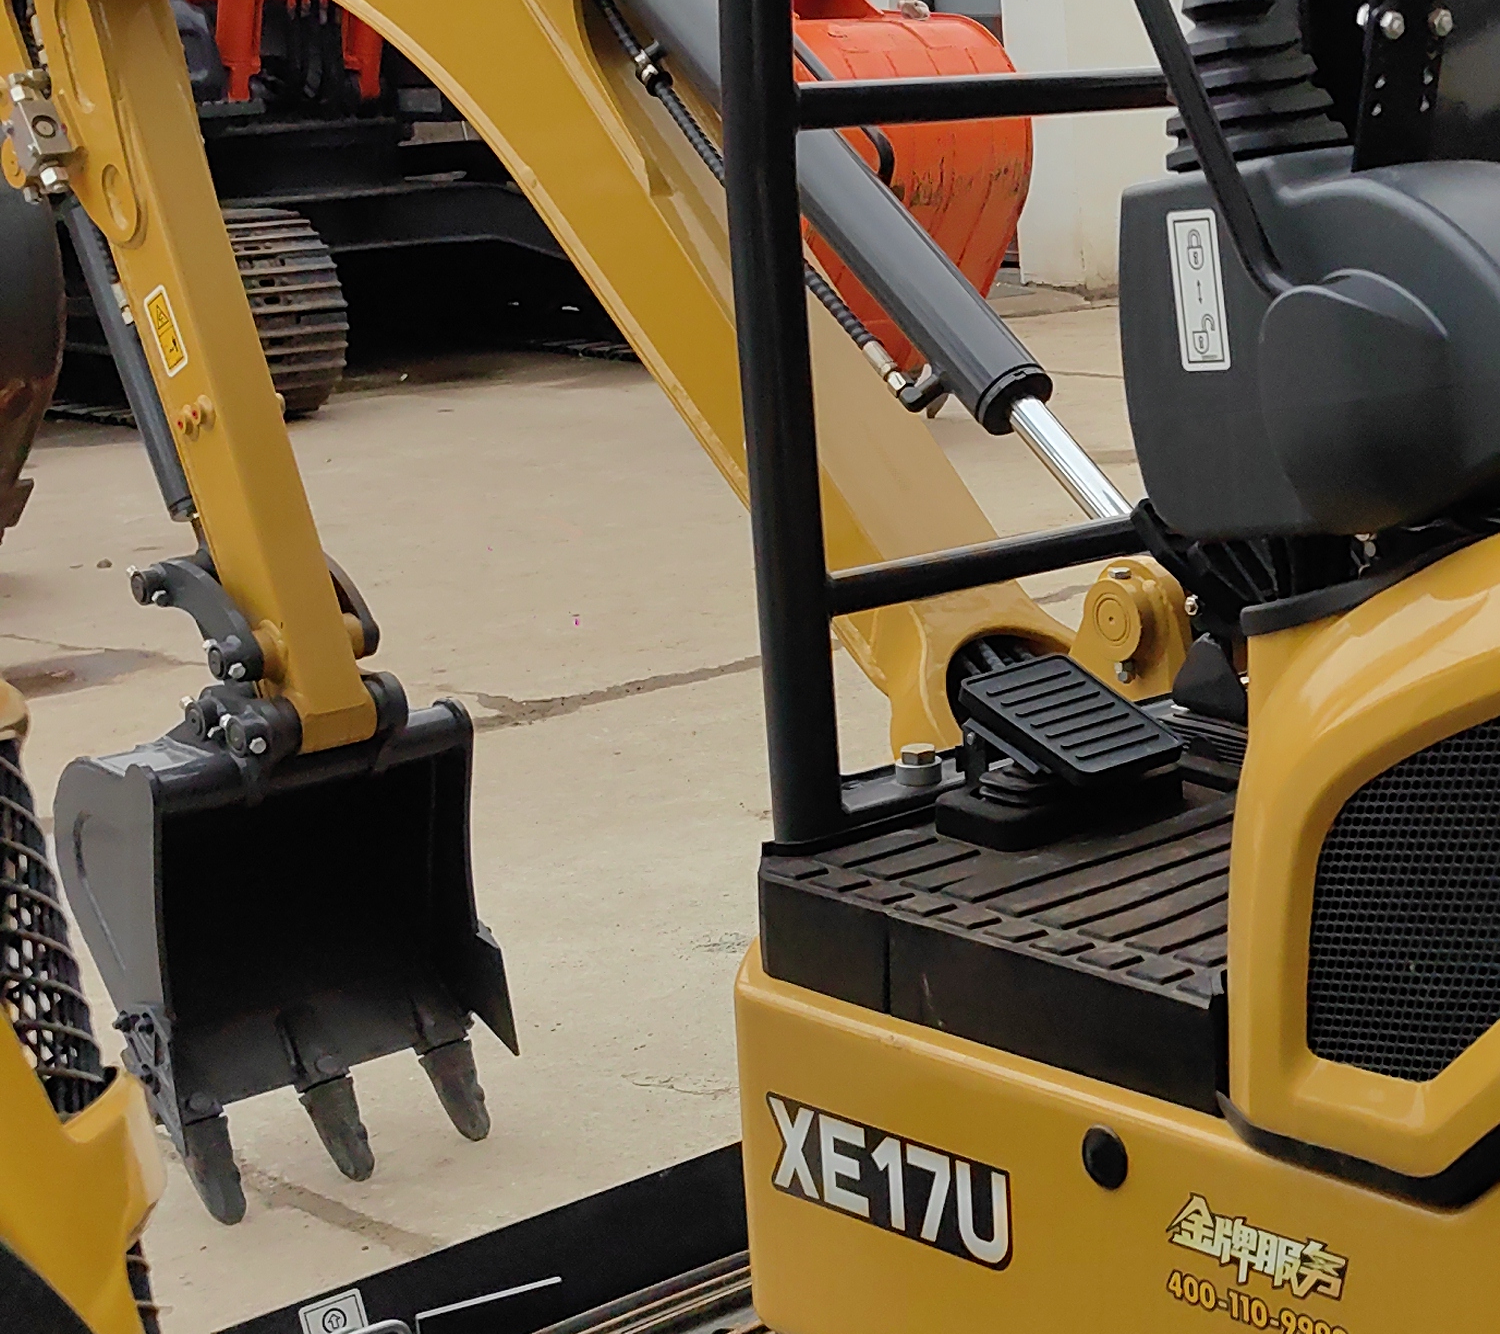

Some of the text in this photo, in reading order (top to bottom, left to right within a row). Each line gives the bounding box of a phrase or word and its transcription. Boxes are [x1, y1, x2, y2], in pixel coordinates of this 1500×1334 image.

[768, 1096, 1009, 1264] XE17U
[1166, 1192, 1349, 1301] 金牌服务
